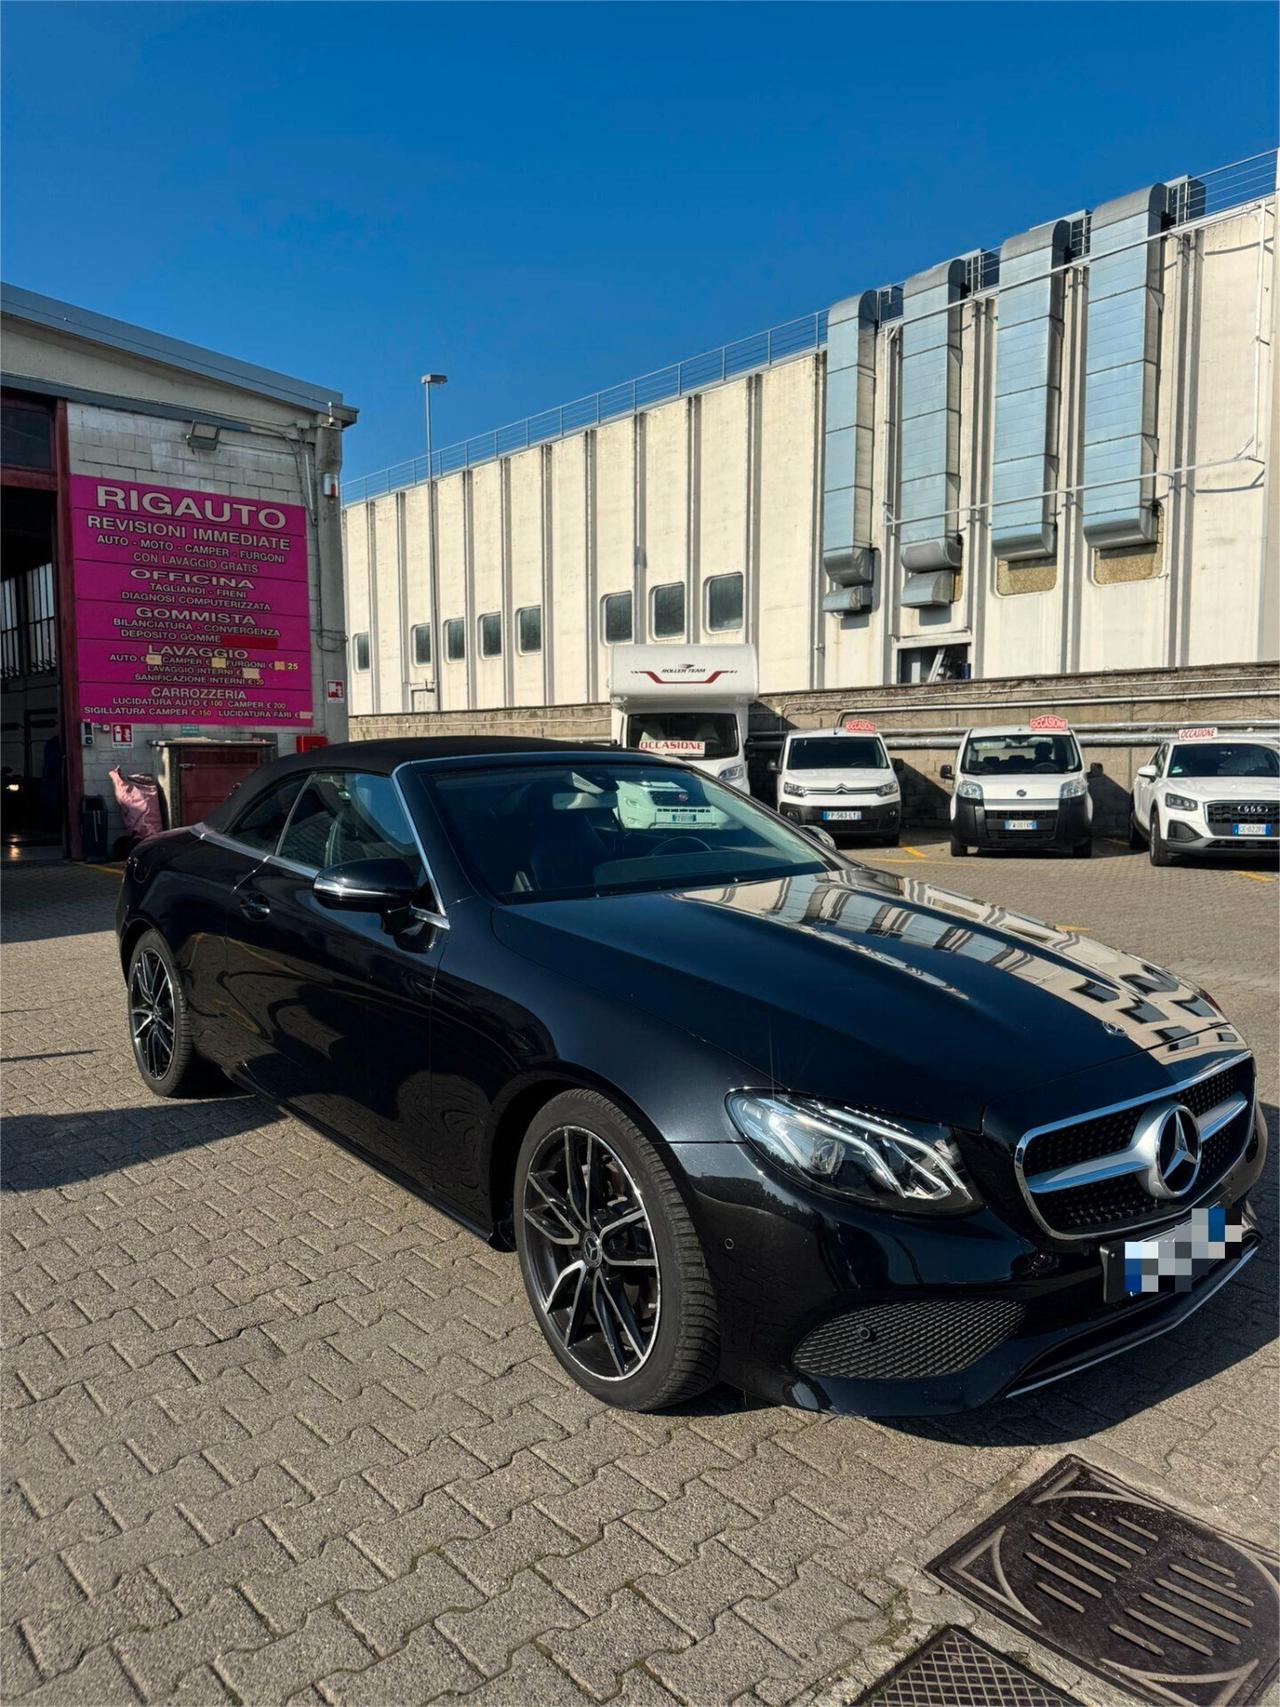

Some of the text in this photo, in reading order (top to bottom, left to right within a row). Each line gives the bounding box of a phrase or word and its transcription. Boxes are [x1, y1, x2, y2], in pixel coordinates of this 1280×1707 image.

[96, 485, 287, 529] RIGAUTO
[87, 515, 290, 550] REVISIONI IMMEDIATE
[97, 535, 128, 546] AUTO
[141, 540, 173, 550] MOTO
[185, 544, 229, 557] CAMPER
[240, 551, 284, 563] FURGONI
[134, 552, 258, 573] CON LAVAGGIO GRATIS
[130, 569, 254, 589] OFFICINA
[150, 583, 205, 594] TAGLIANDI
[217, 589, 246, 598] FRENI
[122, 591, 271, 611] DIAGNOSI COMPUTERIZZATA
[136, 607, 256, 625] GOMMISTA
[113, 618, 193, 630] BILANCIATURA
[204, 624, 281, 636] CONVERGENZA
[121, 629, 221, 643] DEPOSITO GOMME
[148, 644, 248, 659] LAVAGGIO
[109, 654, 137, 662] AUTO
[162, 656, 202, 665] CAMPER
[226, 660, 266, 669] FURGONI
[287, 662, 298, 671] 25
[147, 665, 194, 674] LAVAGGIO
[198, 668, 233, 676] INTERNI
[135, 673, 206, 683] SANIFICAZIONE
[209, 677, 245, 685] INTERNI
[151, 687, 247, 699] CARROZZERIA
[112, 697, 172, 706] LUCIDATURA
[175, 699, 200, 707] AUTO
[227, 701, 264, 709] CAMPER
[84, 706, 146, 715] SIGILLATURA
[149, 708, 188, 716] CAMPER
[218, 710, 271, 718] LUCIDATURA
[273, 711, 292, 719] FARI
[1180, 728, 1215, 739] OCCASIONE
[640, 741, 704, 750] OCCASIONE
